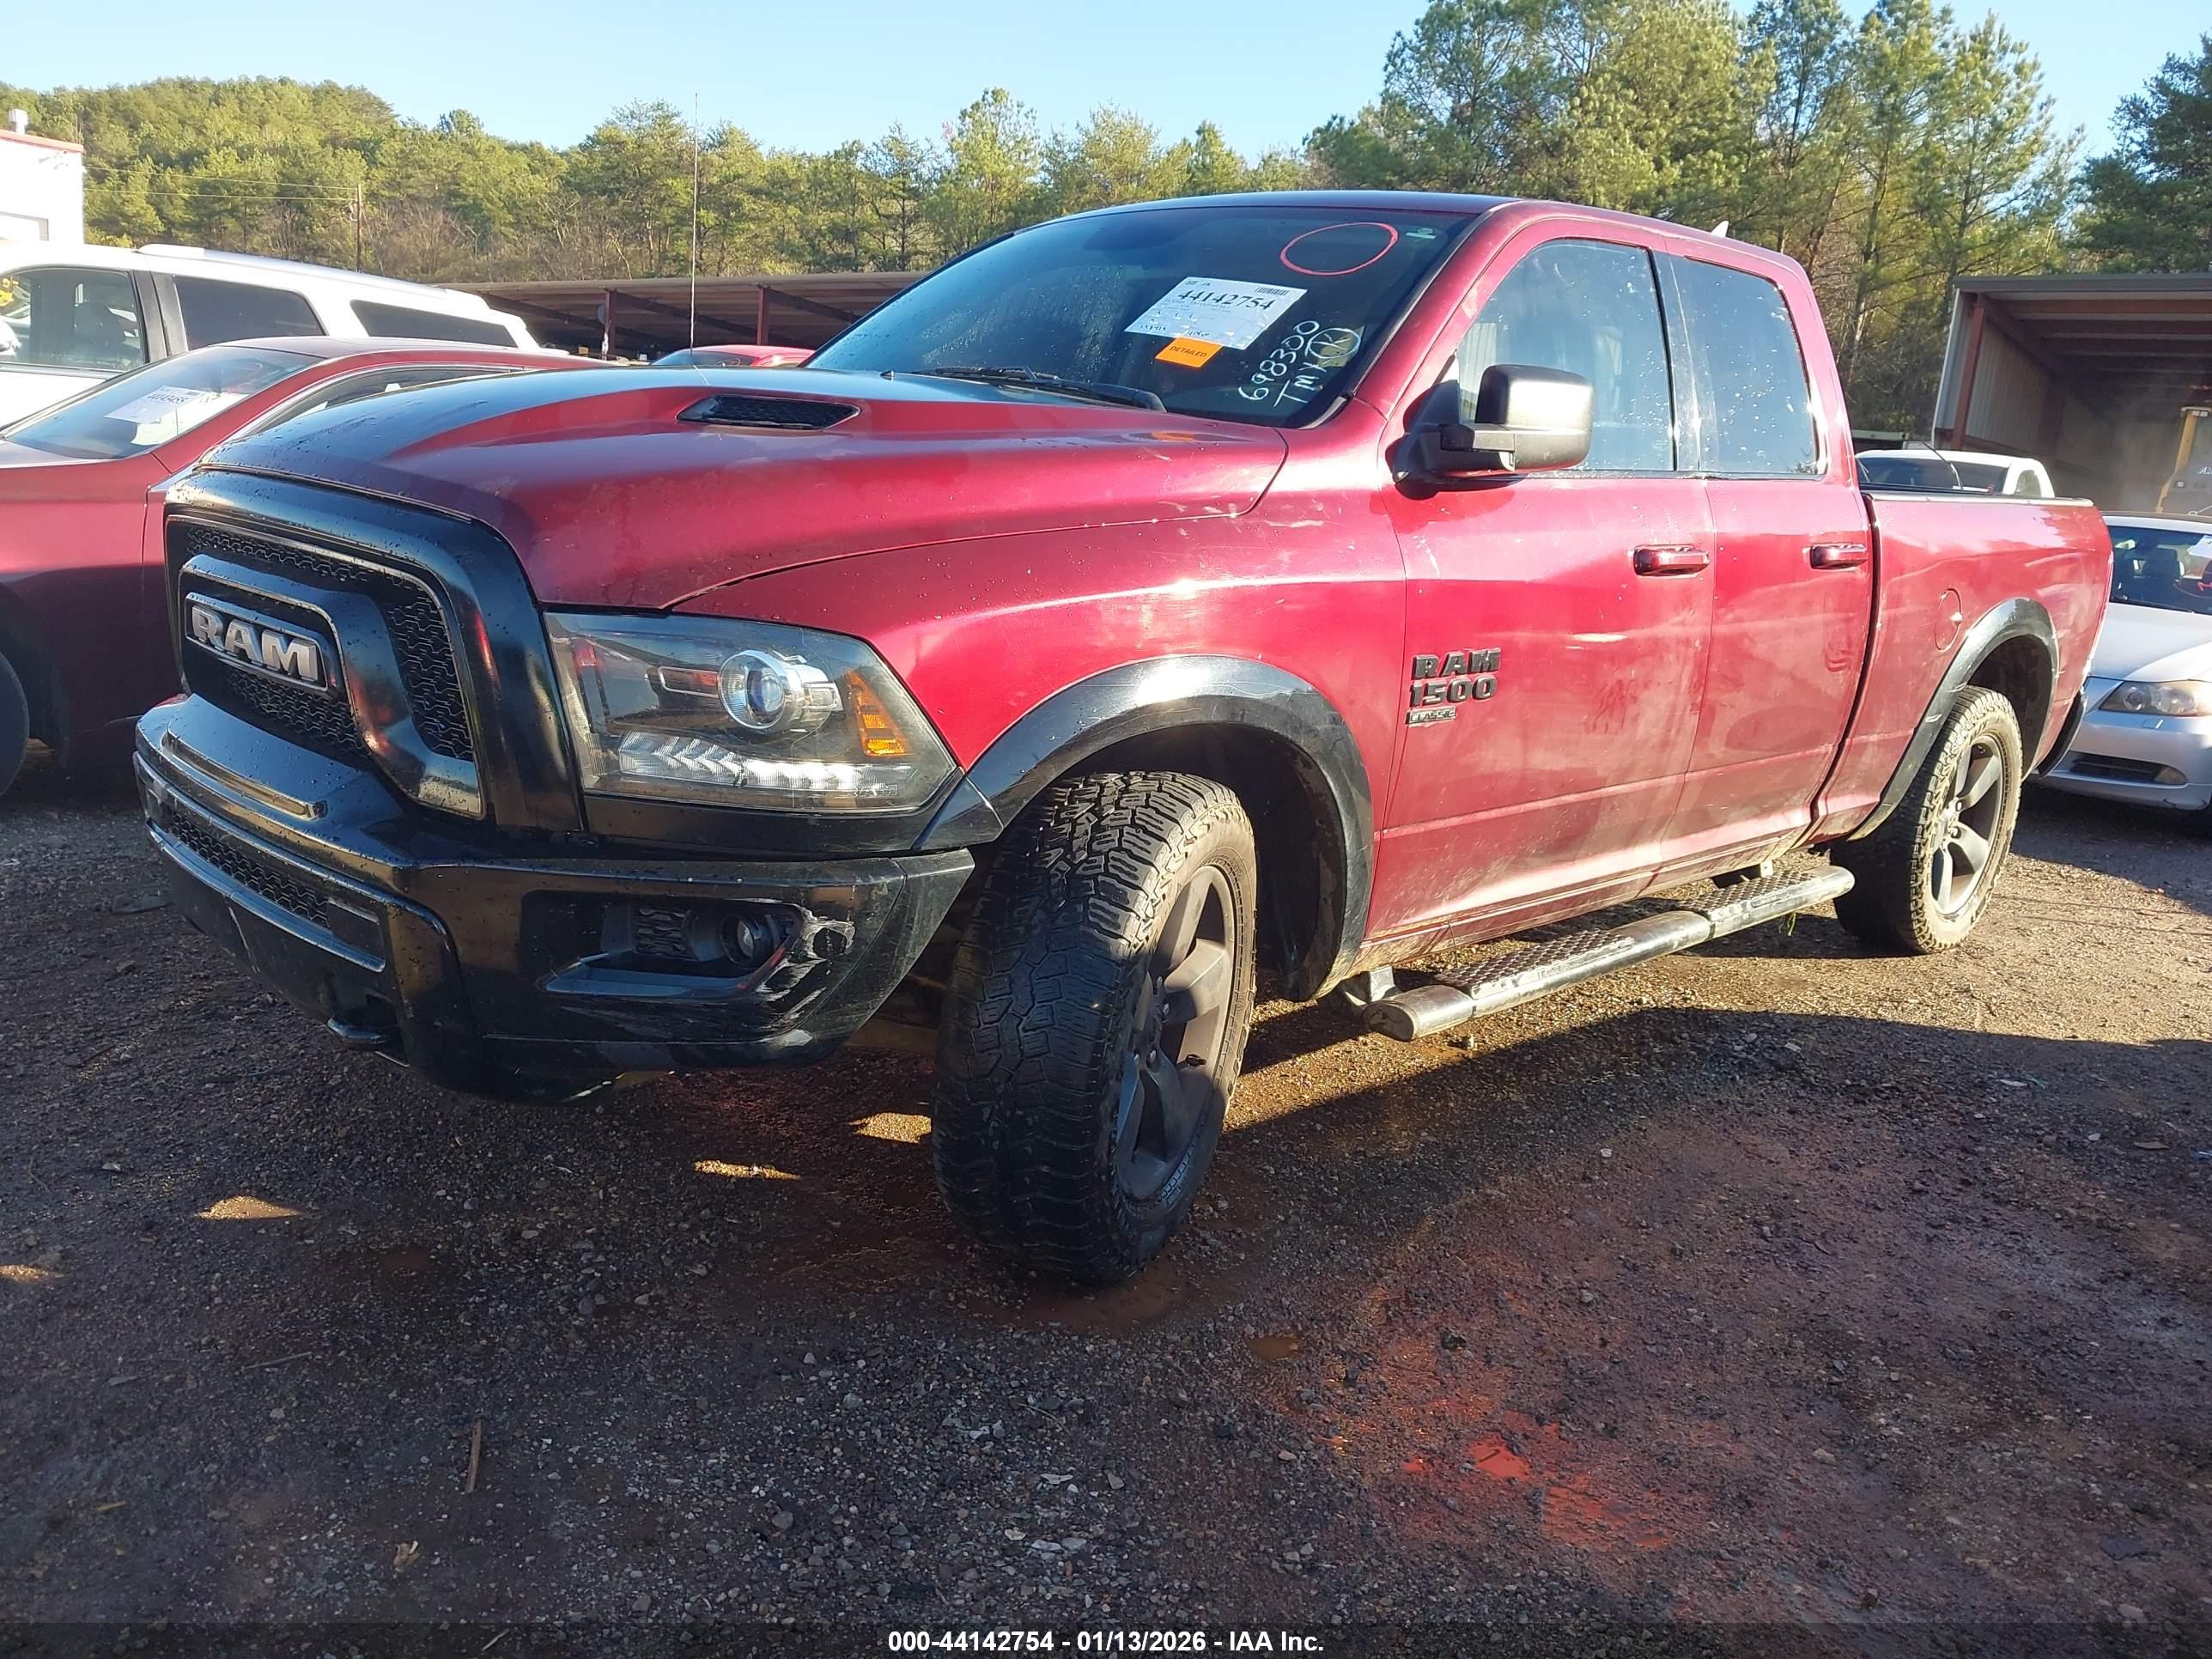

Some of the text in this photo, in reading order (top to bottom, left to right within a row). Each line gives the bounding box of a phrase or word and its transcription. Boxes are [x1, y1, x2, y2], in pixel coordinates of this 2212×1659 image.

[1177, 289, 1276, 310] 44142754
[1169, 345, 1208, 357] DETAILED
[1237, 320, 1320, 400] 698300
[191, 605, 319, 681] RAM
[1411, 647, 1501, 680] RAM
[1409, 675, 1497, 708] 1500
[1406, 707, 1456, 725] CLASSIC
